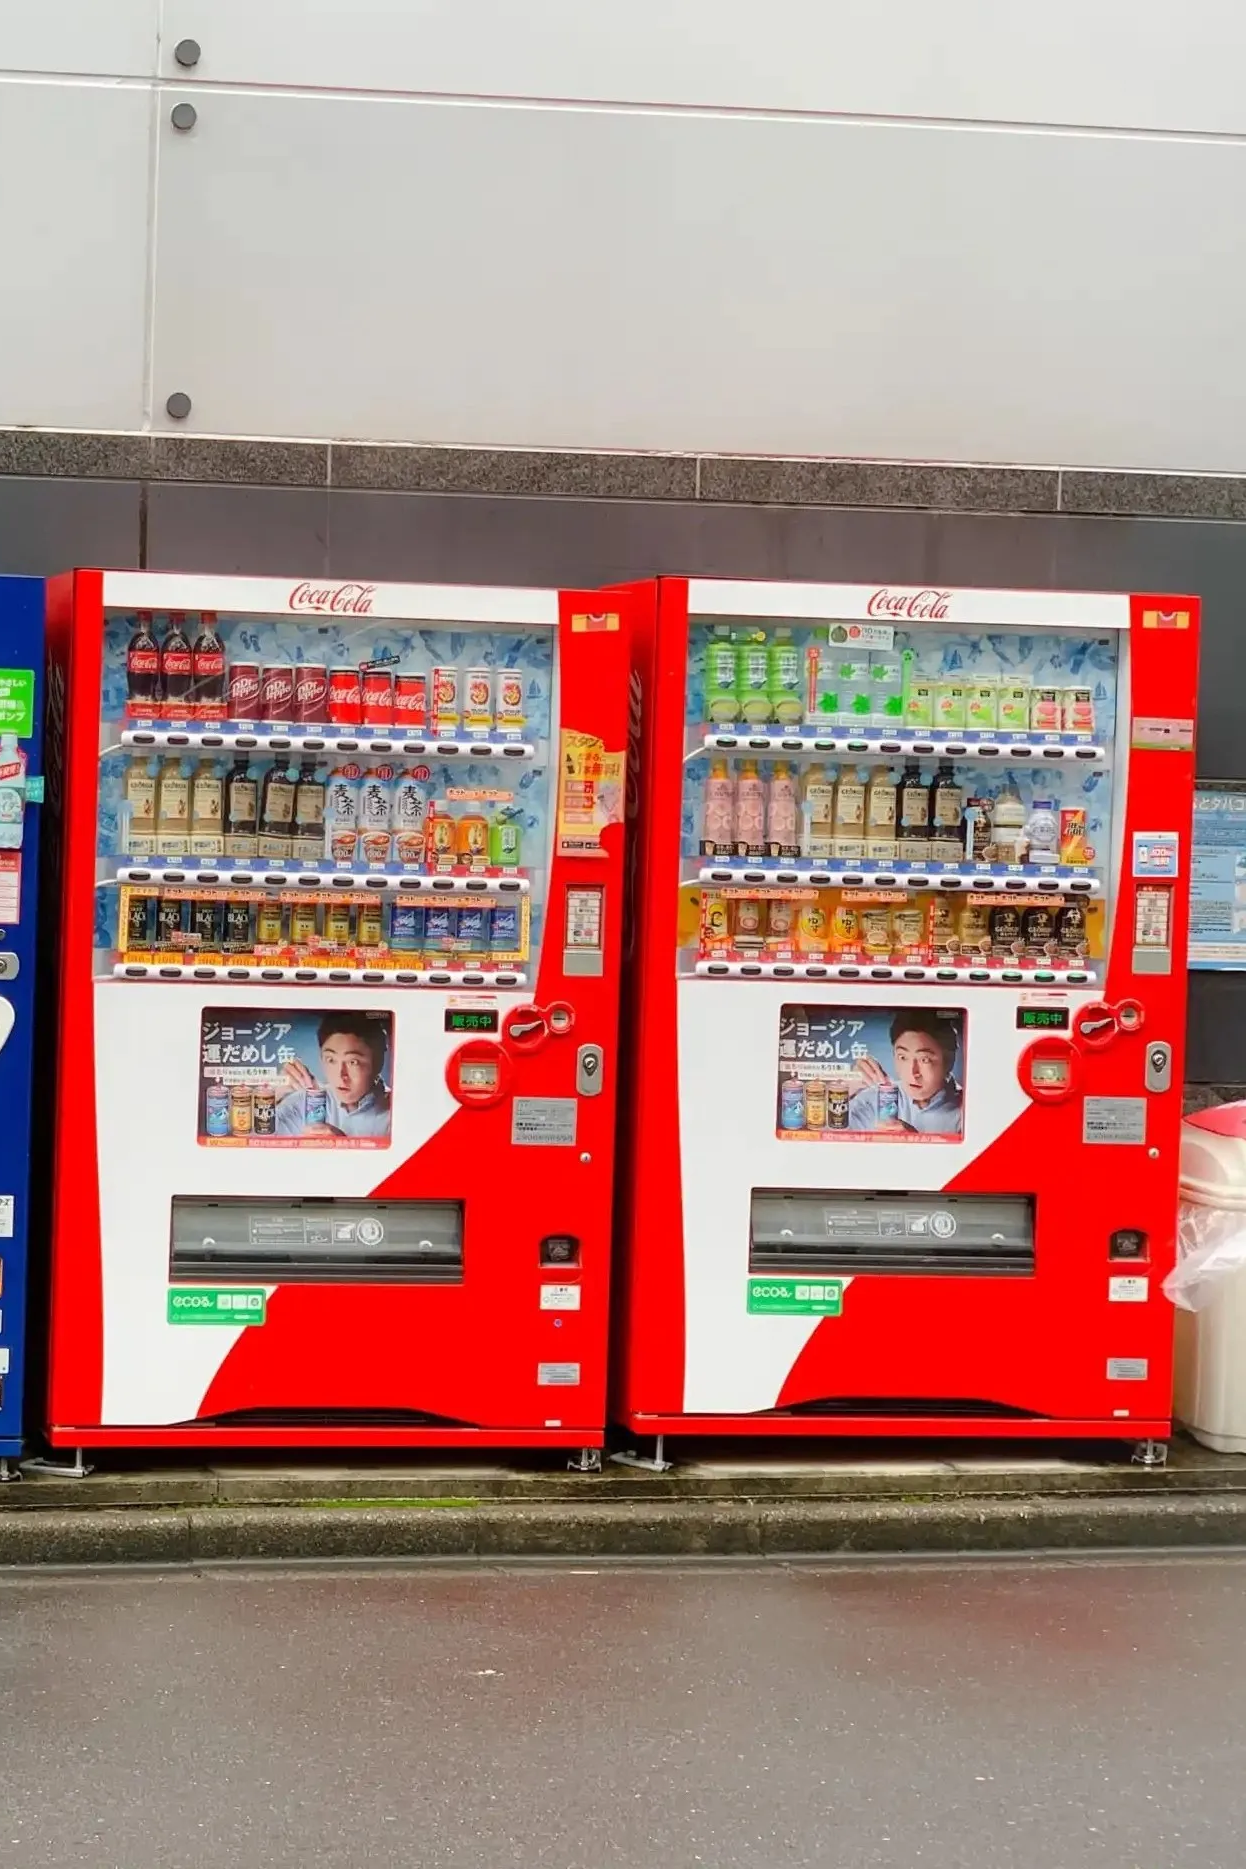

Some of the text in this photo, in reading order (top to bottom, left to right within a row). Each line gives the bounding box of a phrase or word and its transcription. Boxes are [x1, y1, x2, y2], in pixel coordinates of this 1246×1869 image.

[289, 582, 378, 614] Coca-Cola
[867, 588, 953, 619] Coca-Cola
[334, 784, 354, 815] 麦茶
[367, 785, 388, 816] 麦茶
[402, 785, 423, 817] 麦茶
[452, 1015, 492, 1027] 販売中
[779, 1018, 866, 1037] ジョージア
[1023, 1012, 1063, 1025] 販売中
[202, 1022, 292, 1041] ジョージア
[202, 1044, 297, 1064] 運だめし缶
[779, 1039, 869, 1060] 運だめし缶
